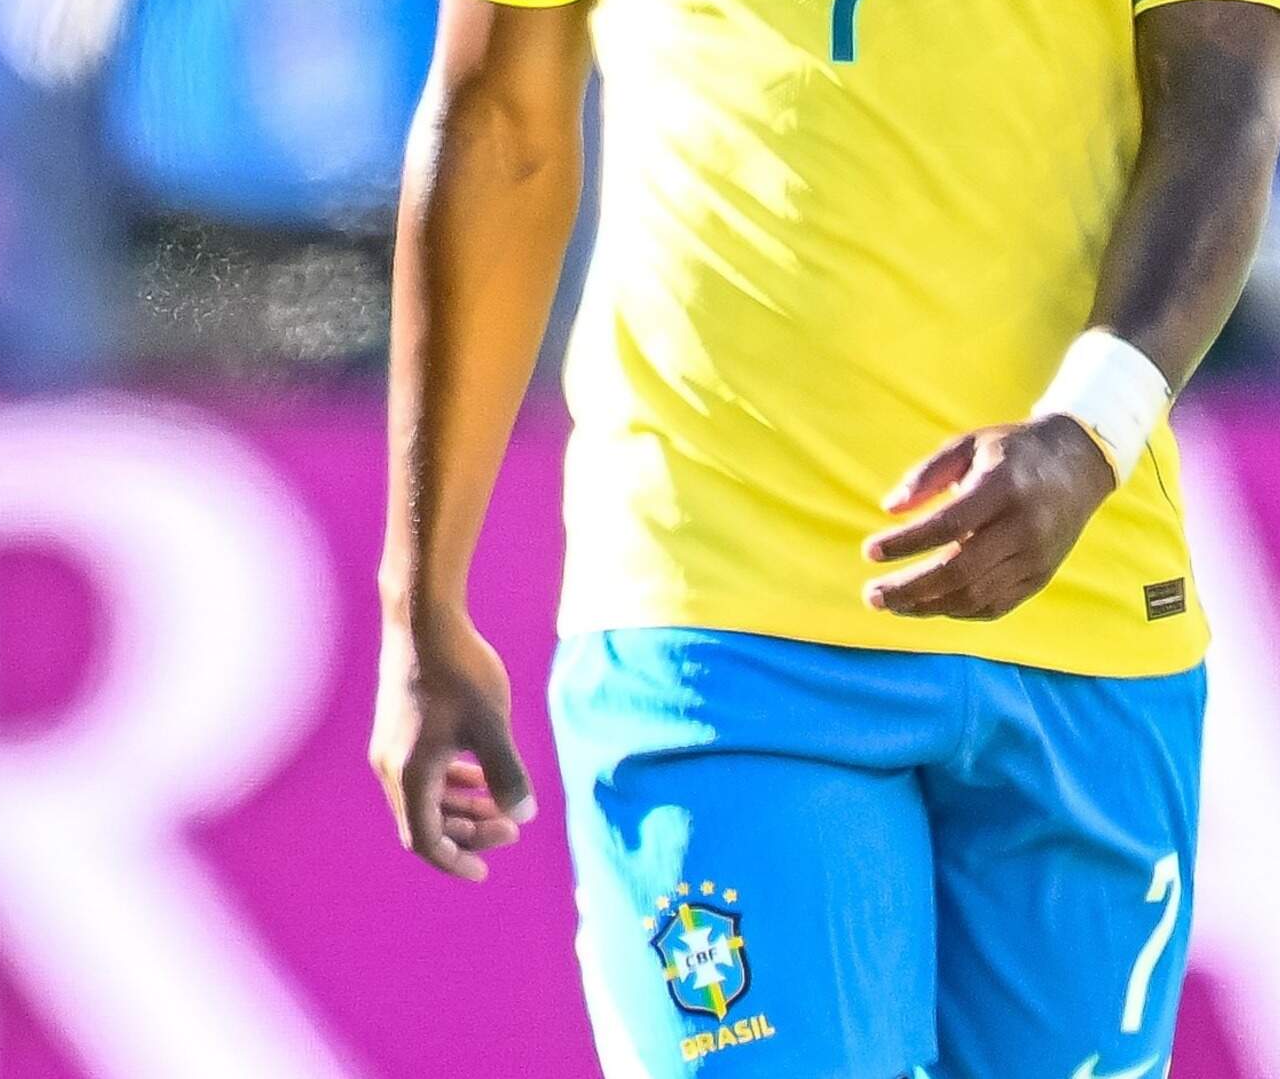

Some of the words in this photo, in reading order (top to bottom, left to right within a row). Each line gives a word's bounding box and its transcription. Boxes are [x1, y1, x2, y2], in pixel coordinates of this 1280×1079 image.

[685, 947, 719, 969] CBF
[1120, 851, 1182, 1035] 7
[680, 1012, 776, 1063] BRASIL
